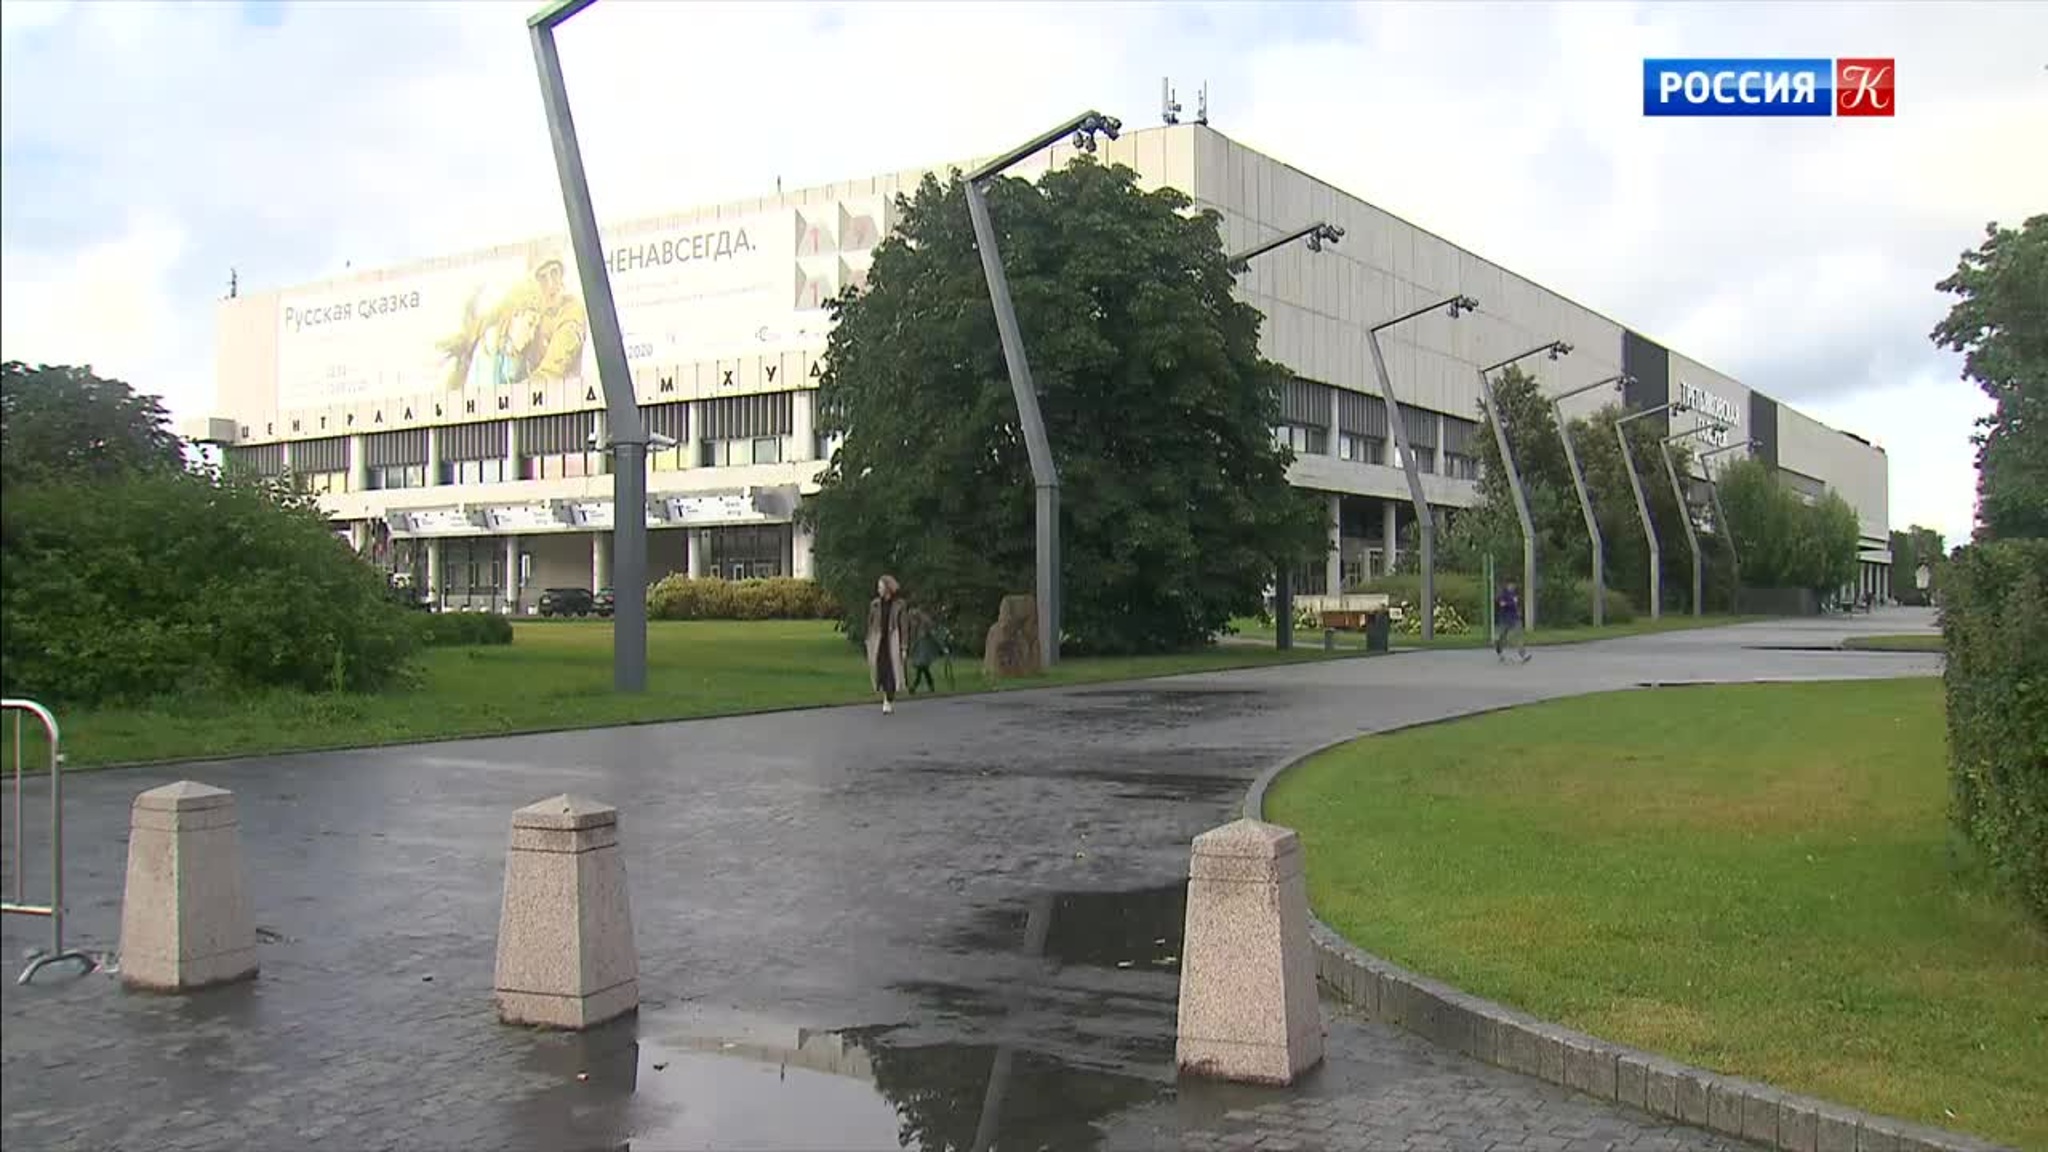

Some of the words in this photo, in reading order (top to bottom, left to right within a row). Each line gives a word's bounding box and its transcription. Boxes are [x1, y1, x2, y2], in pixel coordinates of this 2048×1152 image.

[285, 302, 352, 334] Русская
[358, 290, 421, 319] сказка
[586, 376, 675, 402] ДМ
